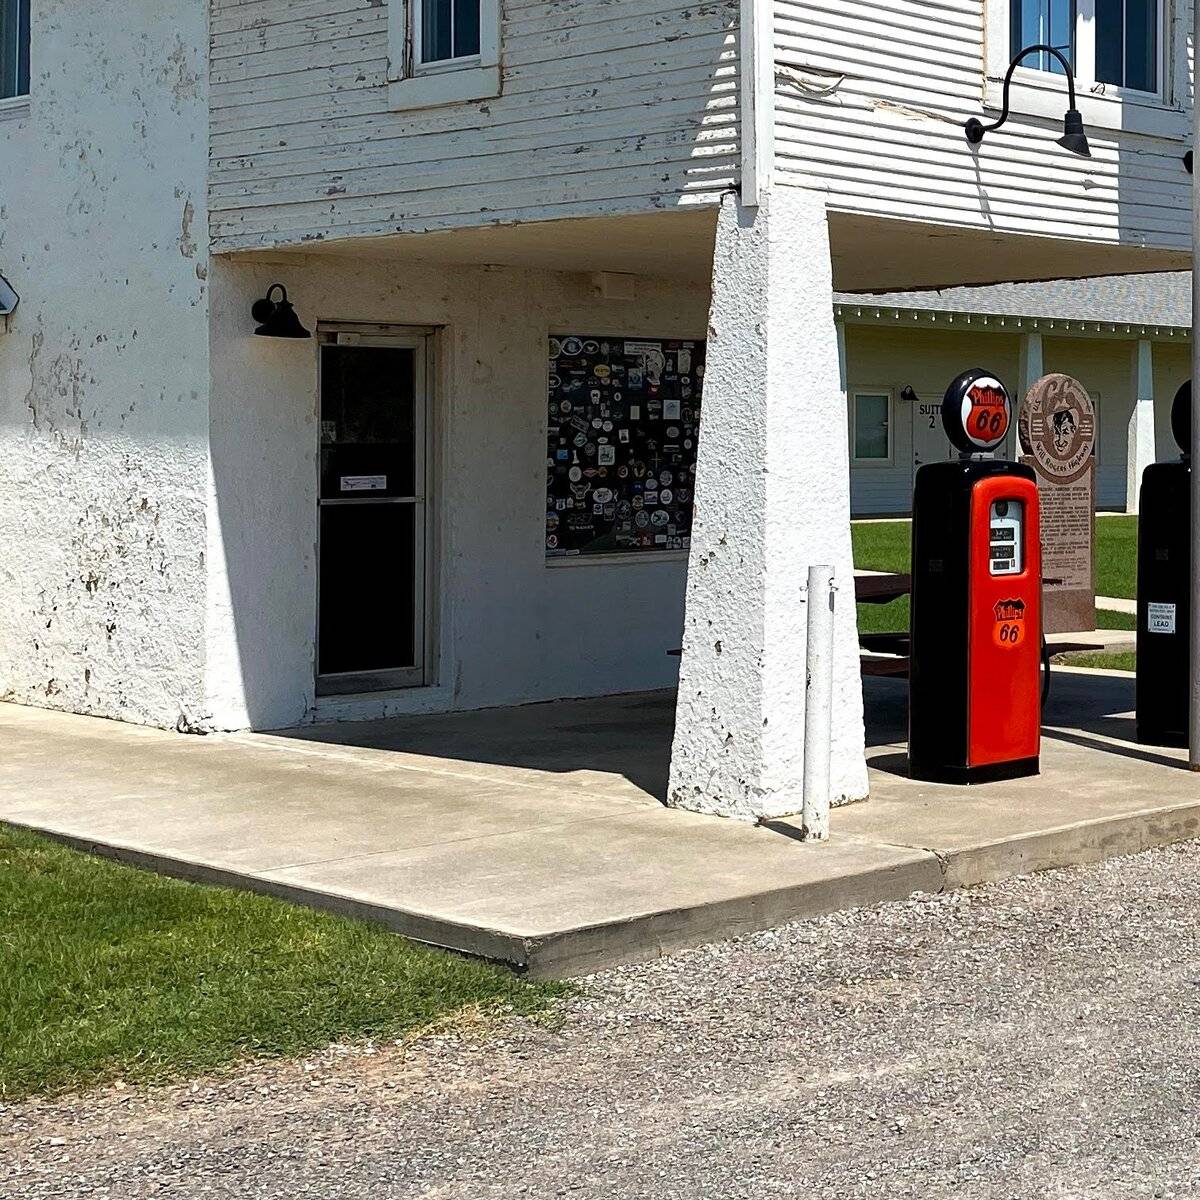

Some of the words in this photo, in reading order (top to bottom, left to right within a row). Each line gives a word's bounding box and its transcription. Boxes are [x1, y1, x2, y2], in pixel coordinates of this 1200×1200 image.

[970, 388, 1004, 407] Phillips
[928, 415, 936, 429] 2
[975, 409, 1003, 433] 66
[1000, 623, 1020, 644] 66
[1153, 620, 1169, 628] LEAD
